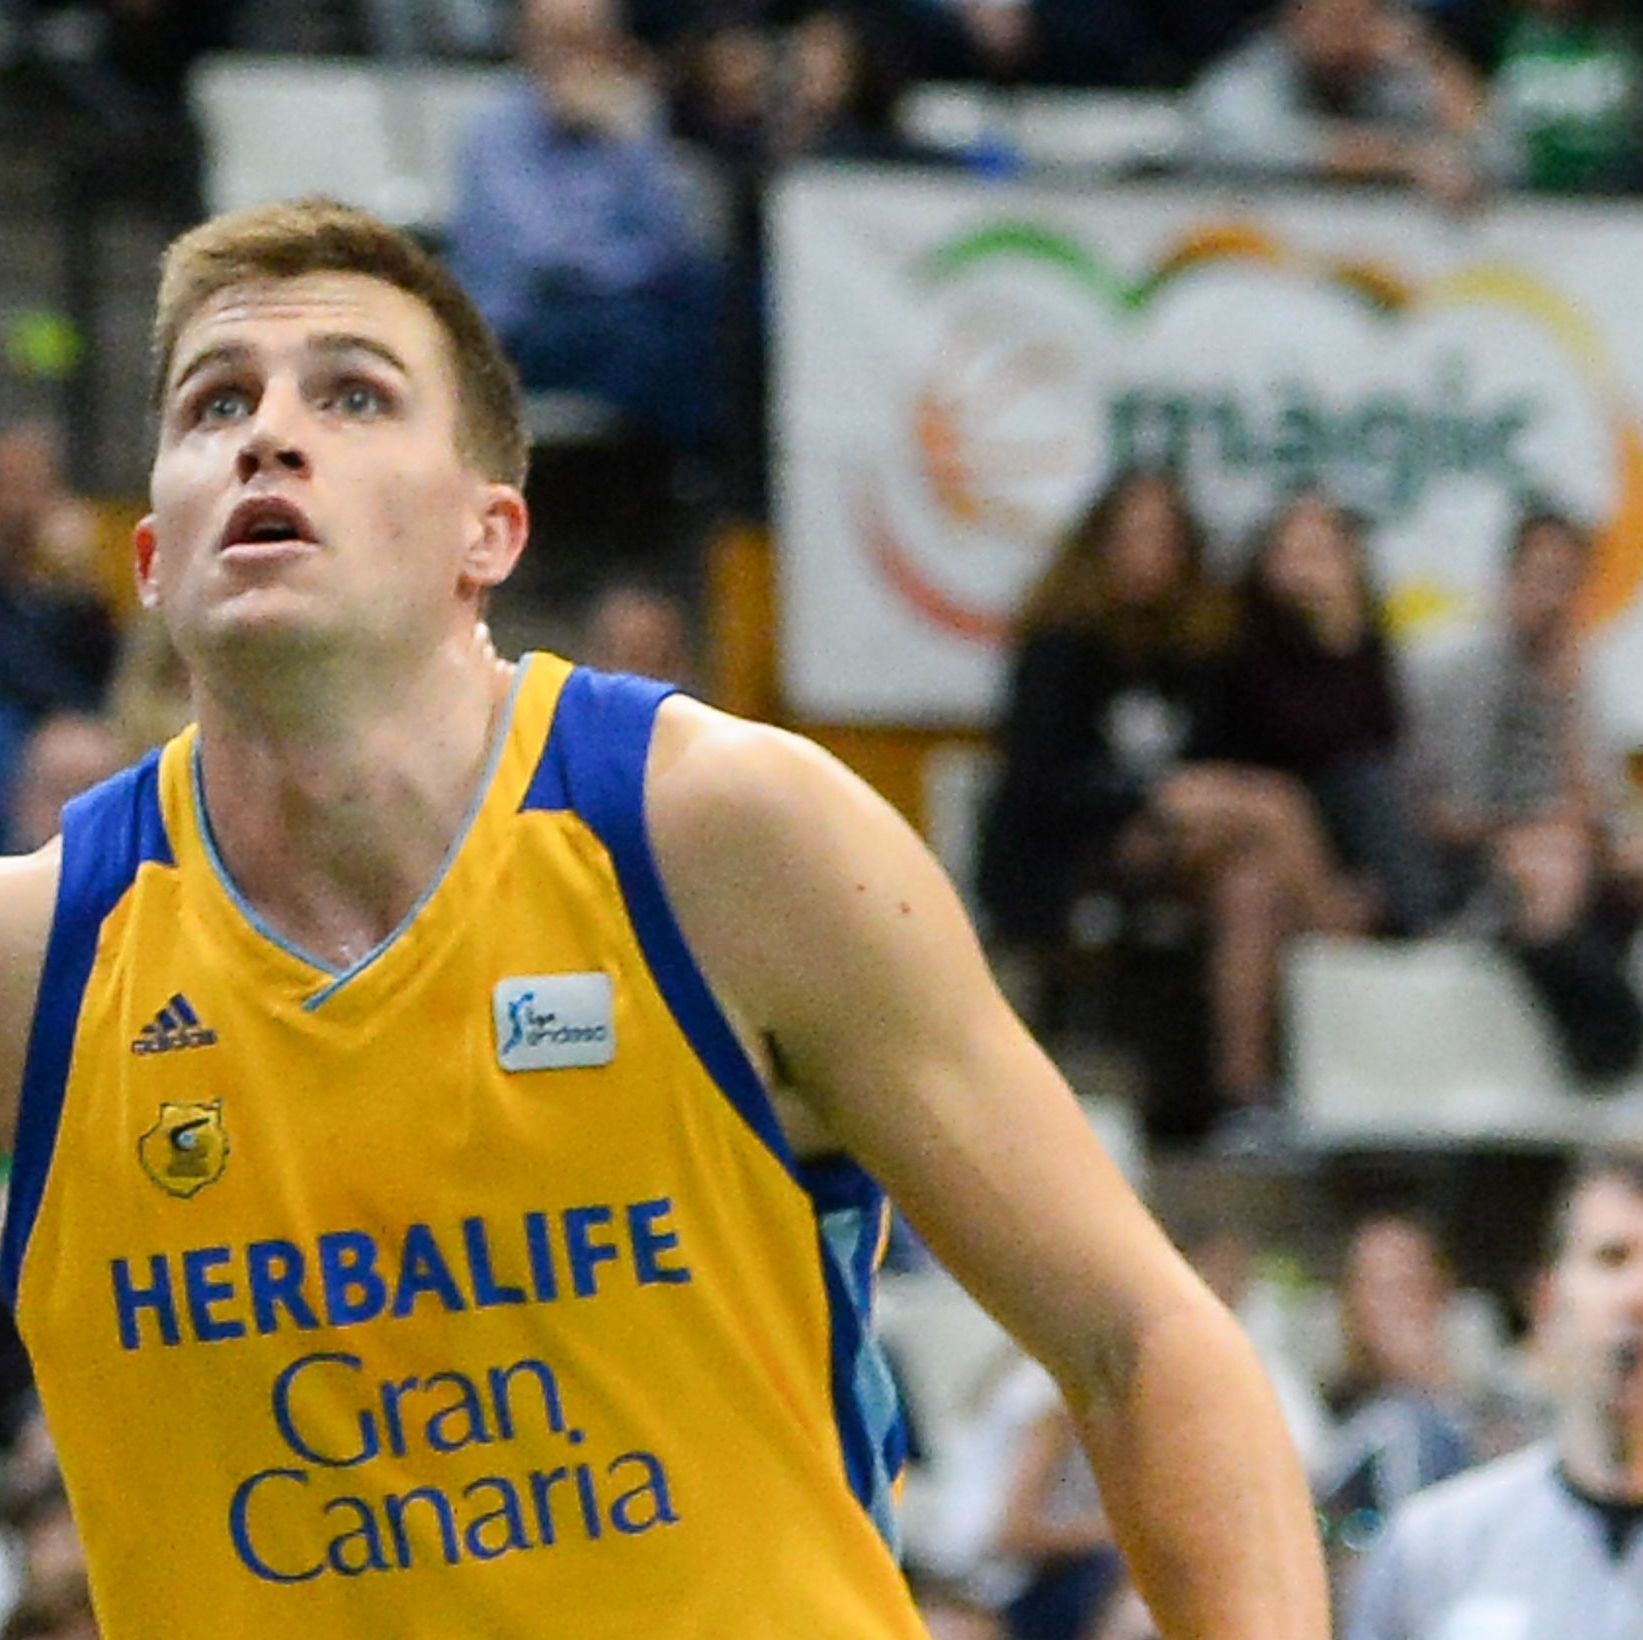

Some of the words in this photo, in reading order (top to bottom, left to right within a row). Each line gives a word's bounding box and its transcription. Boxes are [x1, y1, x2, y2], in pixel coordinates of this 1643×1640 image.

[131, 1029, 219, 1055] adidas
[110, 1198, 692, 1351] HERBALIFE
[228, 1430, 679, 1585] Canaria
